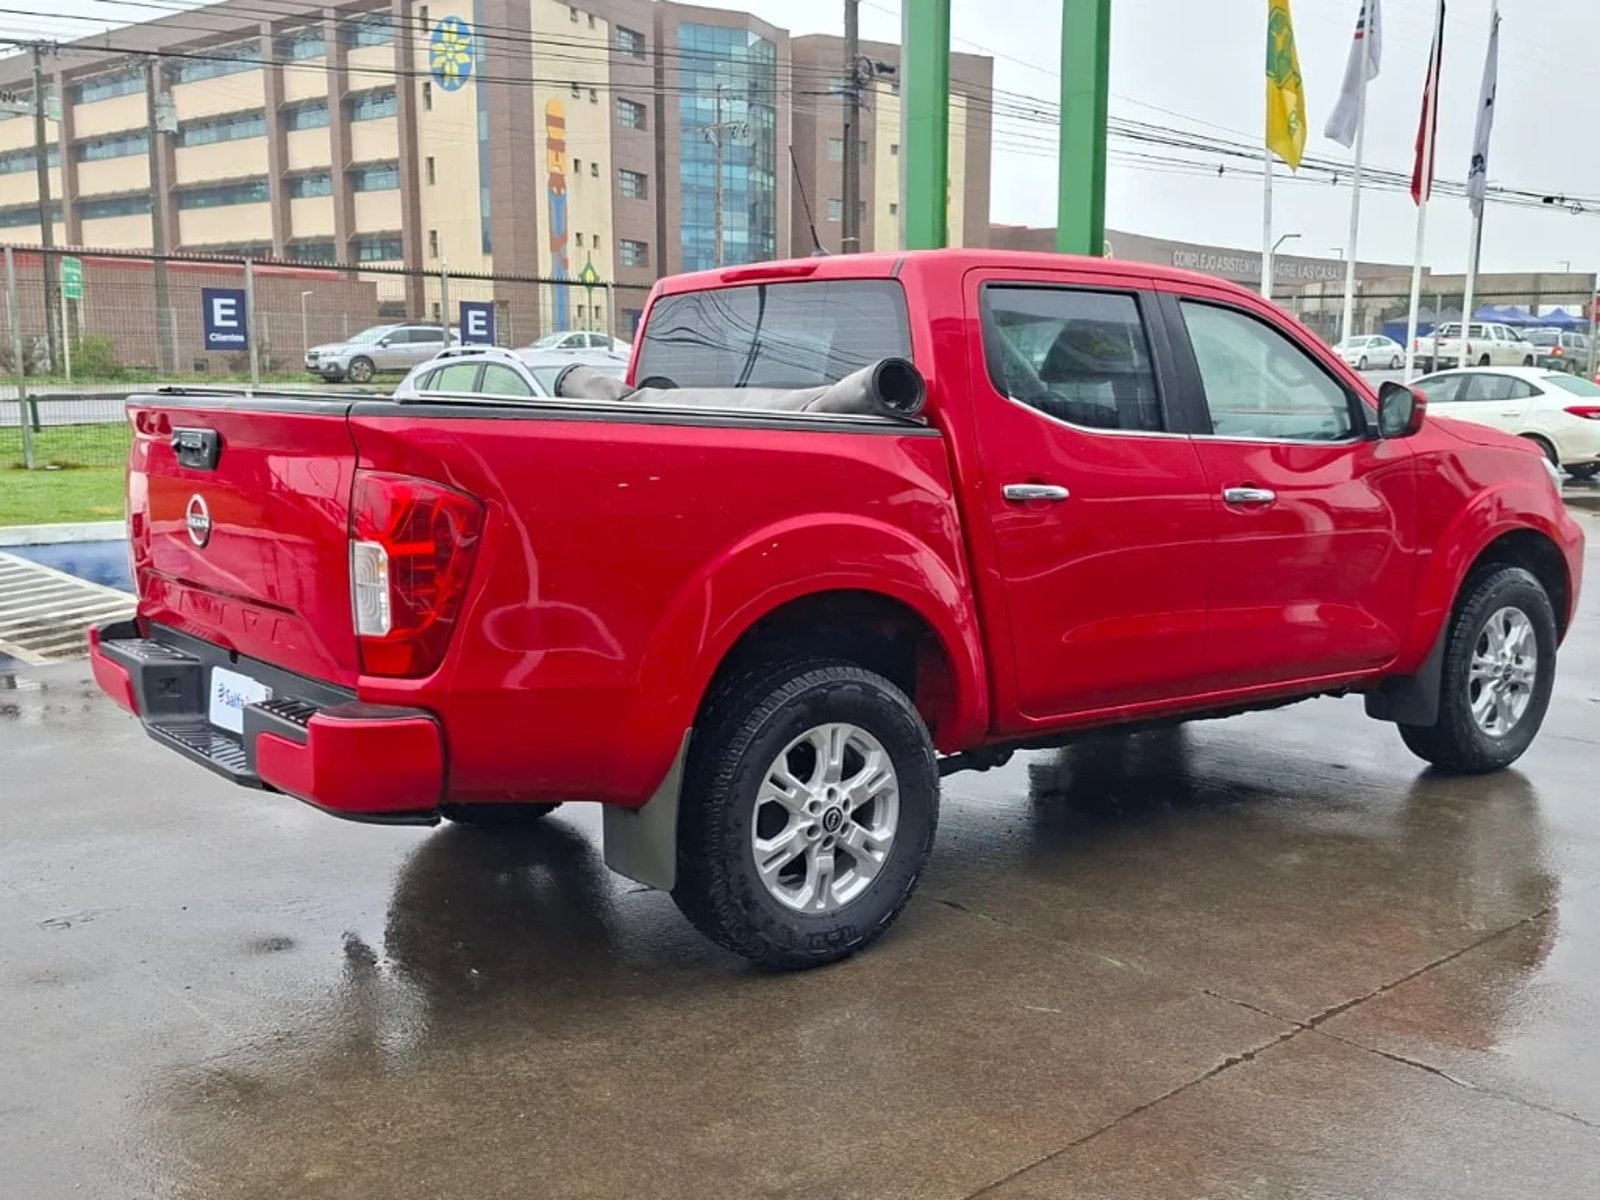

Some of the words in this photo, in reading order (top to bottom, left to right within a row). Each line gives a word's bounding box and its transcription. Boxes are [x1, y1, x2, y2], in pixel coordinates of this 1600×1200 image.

[1173, 250, 1216, 271] COMPLEJO
[1217, 255, 1263, 275] ASISTENCIA
[212, 298, 238, 327] E
[468, 310, 488, 335] E
